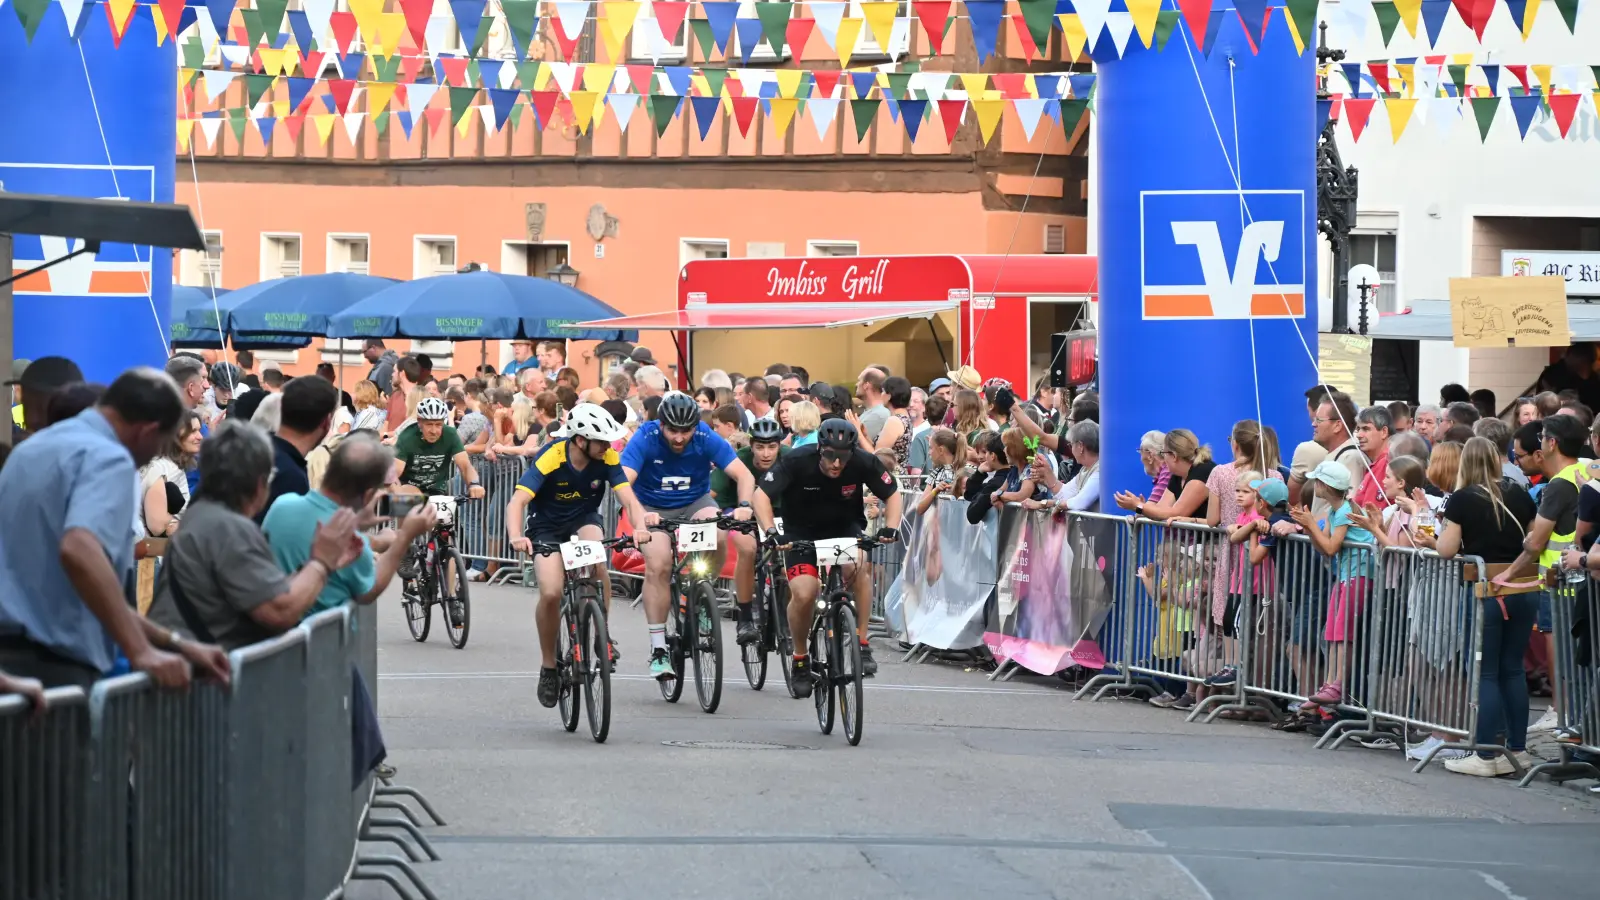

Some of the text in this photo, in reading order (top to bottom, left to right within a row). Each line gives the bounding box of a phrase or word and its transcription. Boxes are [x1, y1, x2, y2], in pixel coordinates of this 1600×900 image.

[767, 258, 890, 299] Imbiss Grill
[435, 317, 483, 327] BISSINGER
[435, 502, 448, 511] 13
[690, 531, 705, 543] 21
[574, 544, 592, 558] 35
[833, 544, 842, 557] 3
